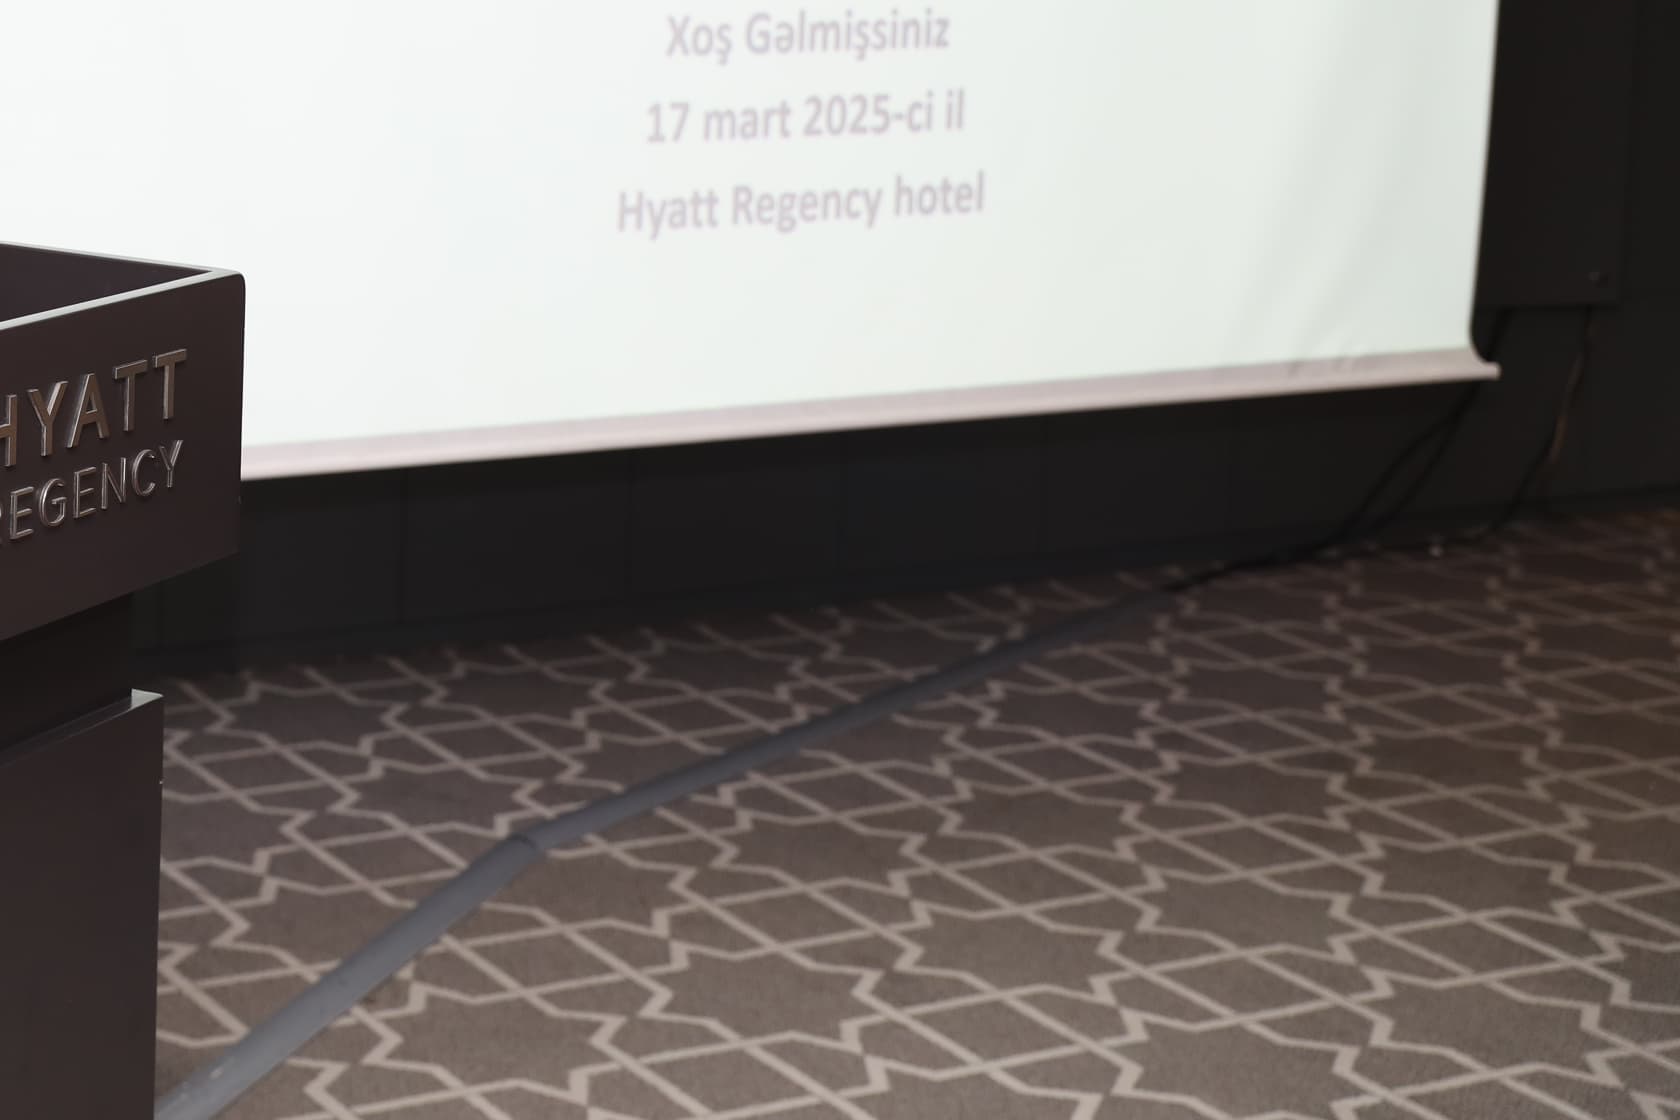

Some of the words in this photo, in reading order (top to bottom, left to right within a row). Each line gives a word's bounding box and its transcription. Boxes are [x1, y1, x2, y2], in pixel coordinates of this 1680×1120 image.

[665, 15, 734, 67] Xoş
[744, 7, 951, 62] Gəlmişsiniz
[647, 101, 691, 145] 17
[703, 99, 793, 142] mart
[802, 89, 935, 138] 2025-ci
[944, 87, 966, 131] il
[617, 188, 720, 241] Hyatt
[731, 184, 884, 235] Regency
[893, 169, 985, 217] hotel
